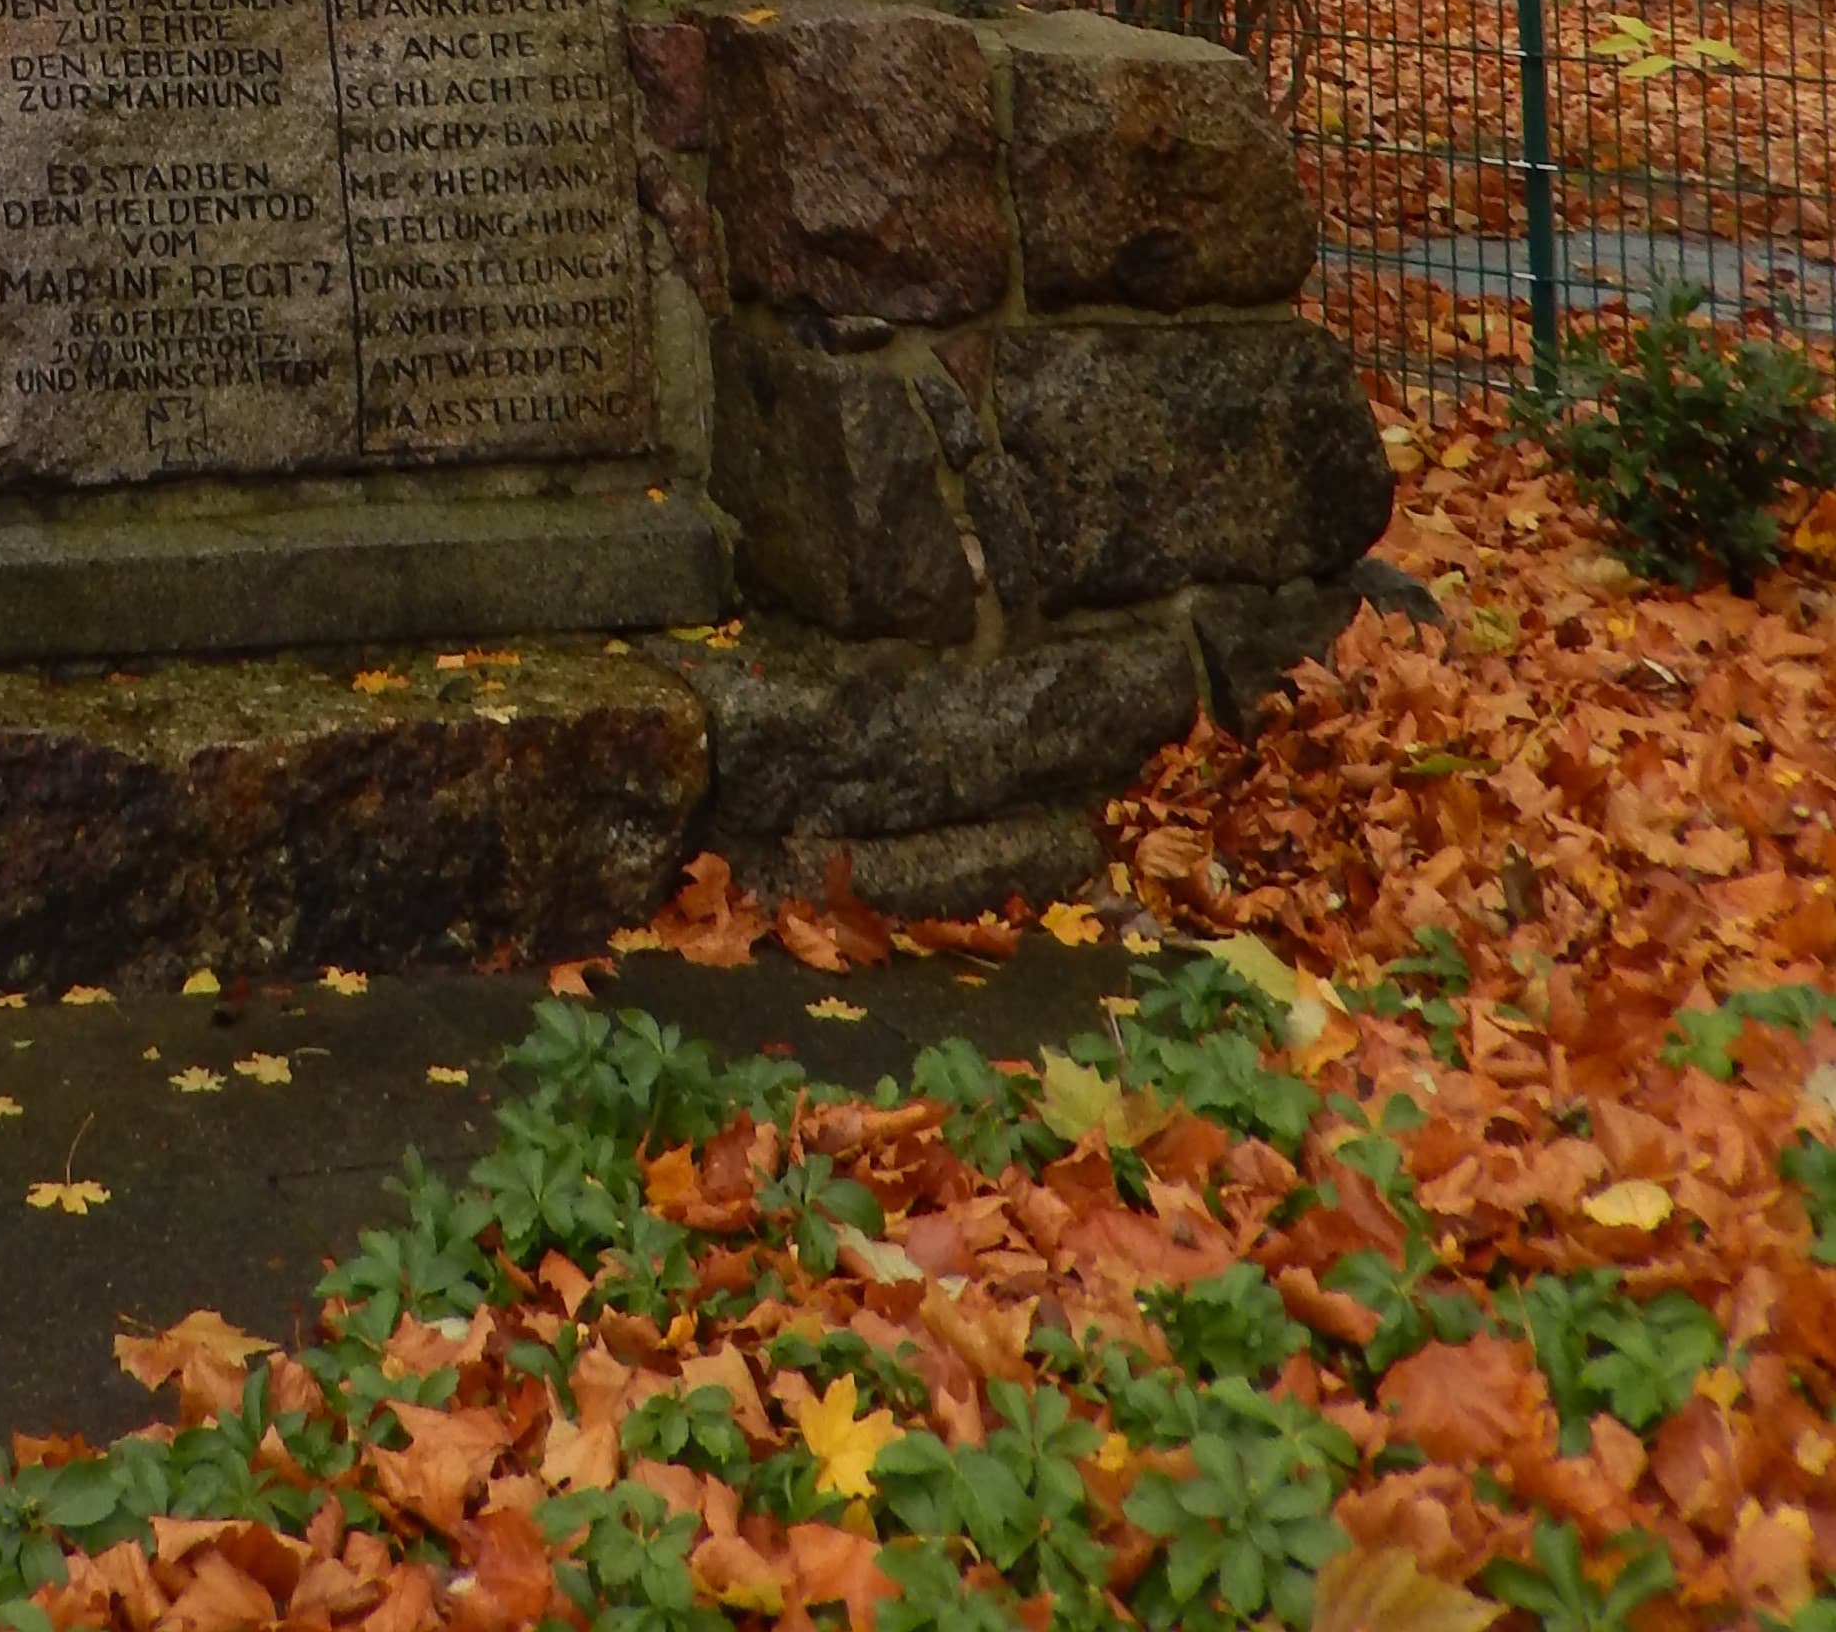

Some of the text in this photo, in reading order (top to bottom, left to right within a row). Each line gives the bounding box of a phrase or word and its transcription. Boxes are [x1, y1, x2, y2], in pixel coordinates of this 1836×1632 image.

[53, 15, 236, 47] ZUR EHRE
[402, 30, 539, 63] ANCRE
[10, 47, 285, 82] DEN LEBENDEN
[16, 80, 283, 112] ZUR MAHNUNG
[345, 73, 604, 110] SCHLACHT BEI
[46, 160, 270, 196] ES STARBEN
[349, 172, 399, 201] ME
[3, 193, 315, 230] DEN HELDENTOD
[120, 230, 198, 258] VOM
[354, 212, 519, 245] STELLUNG
[360, 254, 602, 293] DINGSTELLUNG
[110, 306, 265, 337] OFFIZIERE
[503, 302, 563, 330] VOR
[571, 296, 629, 326] DER
[14, 367, 76, 395] UND
